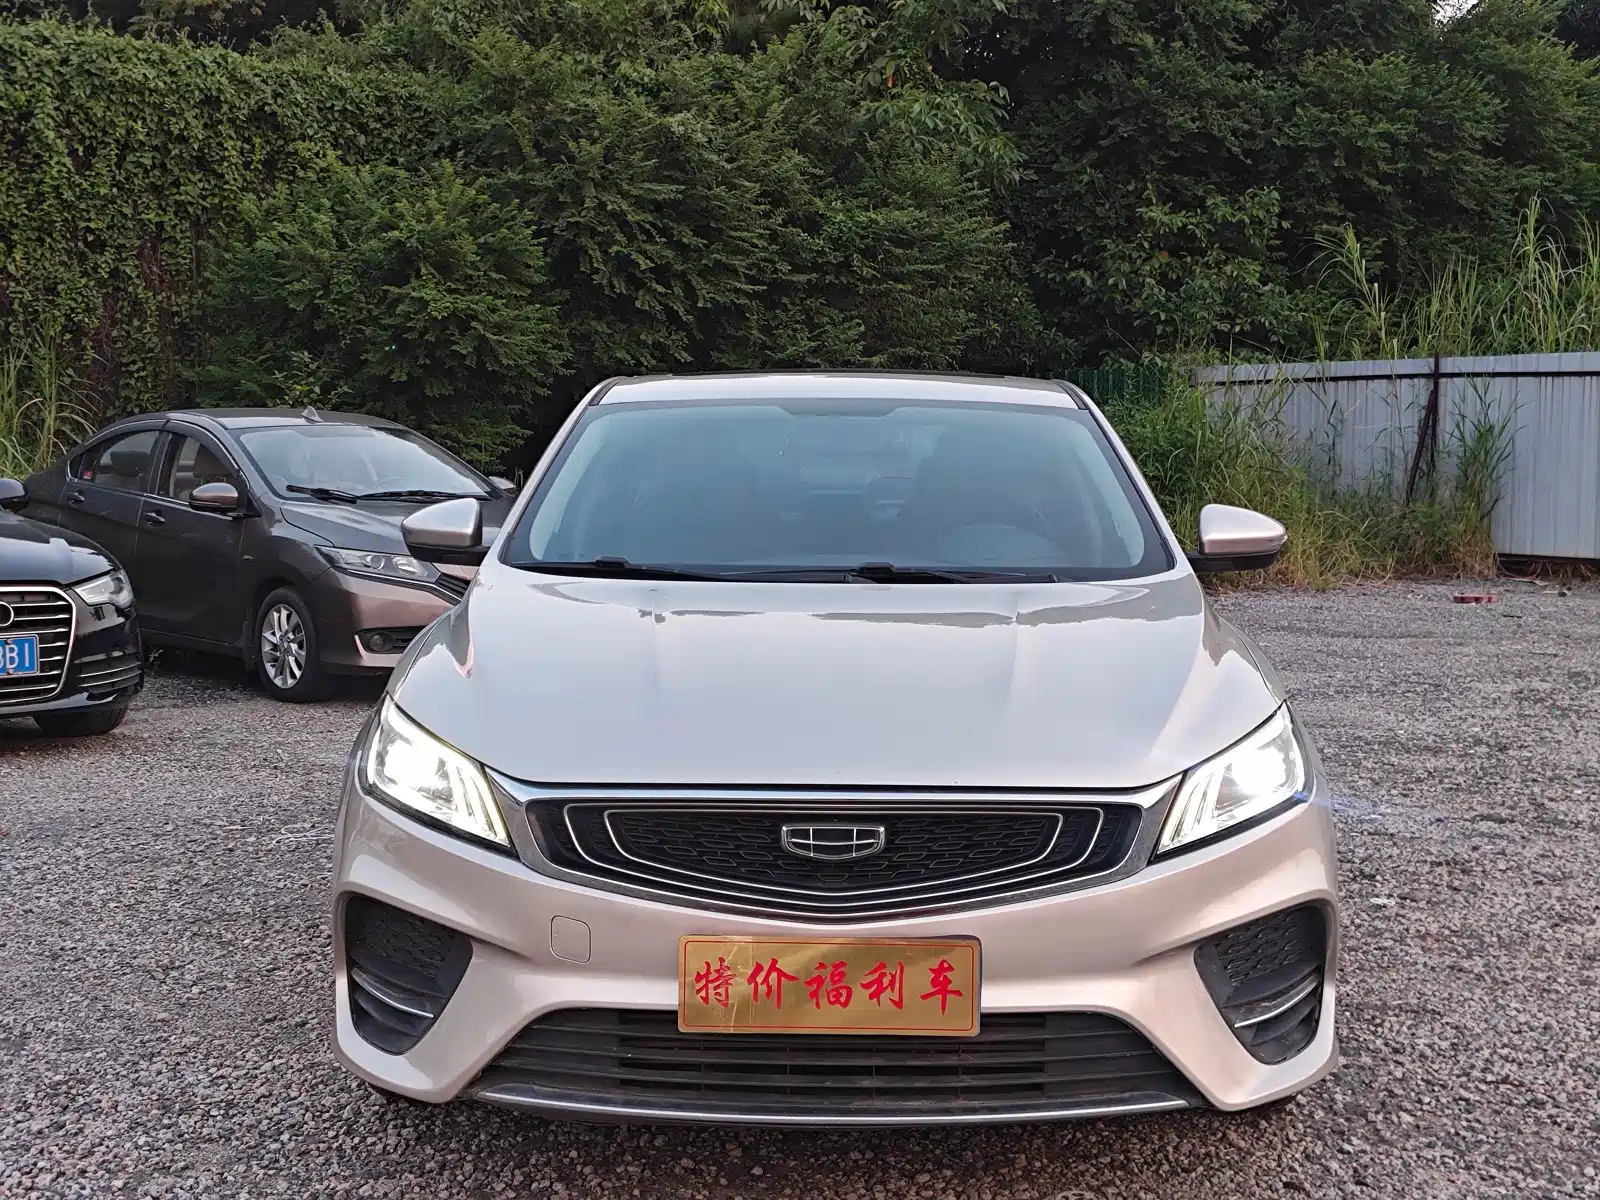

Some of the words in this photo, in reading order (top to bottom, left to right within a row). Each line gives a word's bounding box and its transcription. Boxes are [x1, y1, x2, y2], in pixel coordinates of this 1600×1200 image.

[693, 956, 964, 1016] 特价福利车
